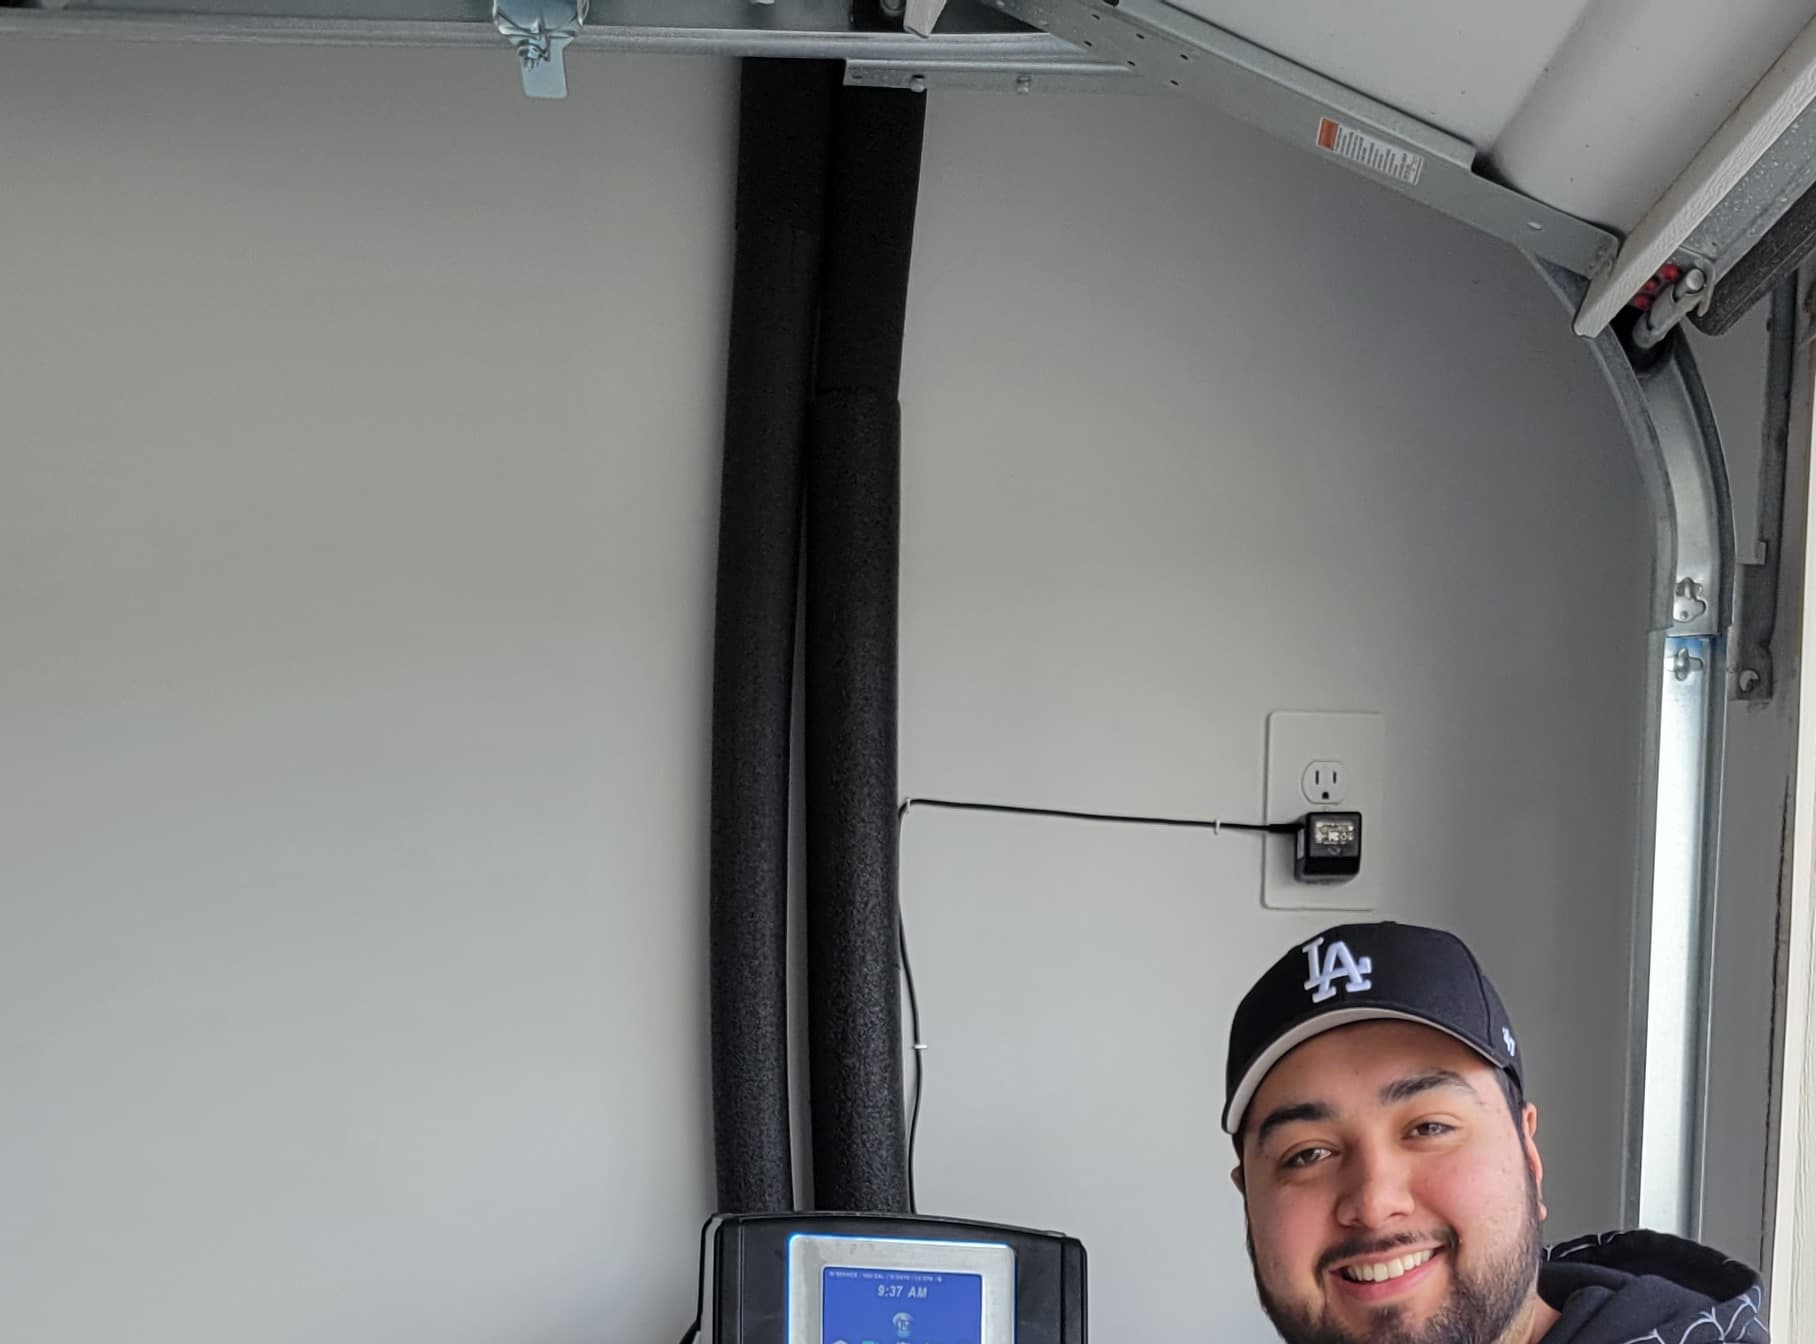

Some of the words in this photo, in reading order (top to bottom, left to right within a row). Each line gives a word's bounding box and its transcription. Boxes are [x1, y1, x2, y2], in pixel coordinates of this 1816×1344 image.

[1302, 937, 1372, 1003] LA
[878, 1284, 903, 1297] 9:37
[907, 1286, 928, 1298] AM
